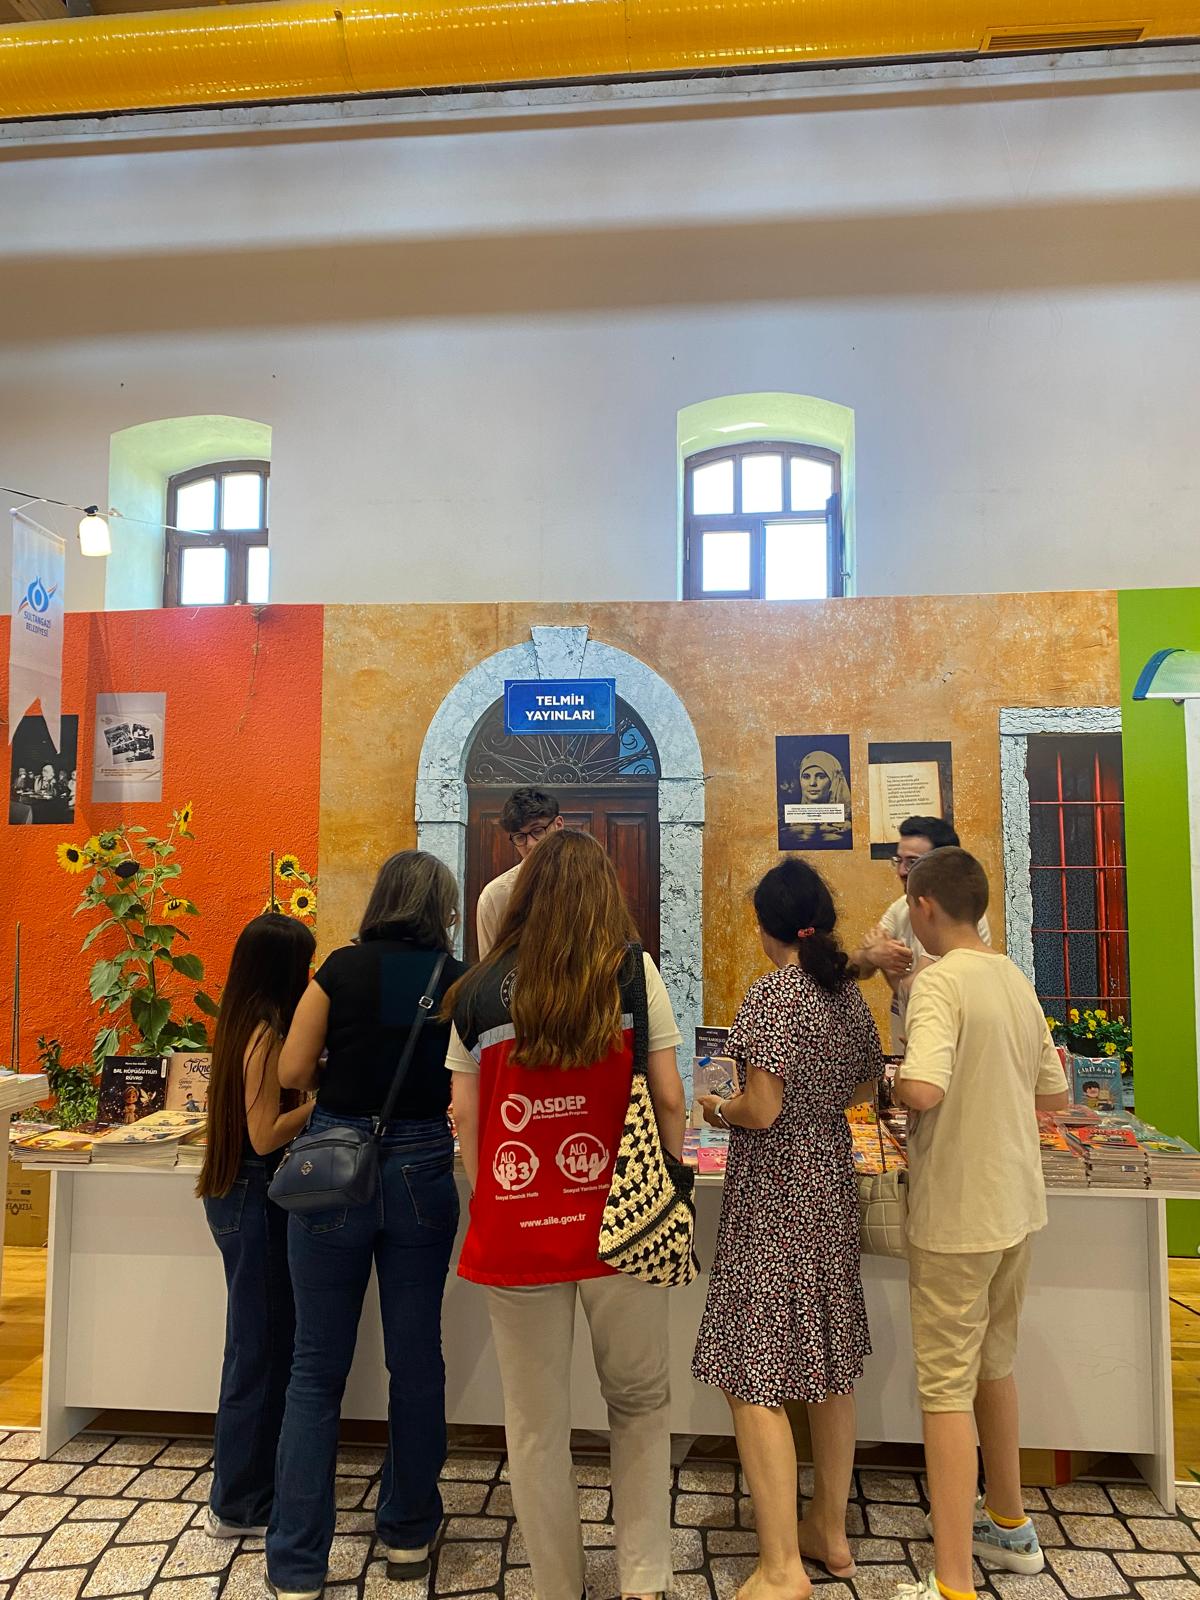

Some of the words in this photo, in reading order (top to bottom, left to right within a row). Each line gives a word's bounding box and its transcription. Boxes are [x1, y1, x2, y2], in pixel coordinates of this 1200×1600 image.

[536, 693, 585, 706] TELMİH
[525, 709, 595, 721] YAYINLARI
[532, 1095, 587, 1115] ASDEP
[569, 1142, 587, 1156] ALO
[500, 1151, 516, 1164] ALO
[565, 1152, 600, 1174] 144
[497, 1161, 530, 1181] 183
[519, 1212, 586, 1228] www.aile.gov.tr
